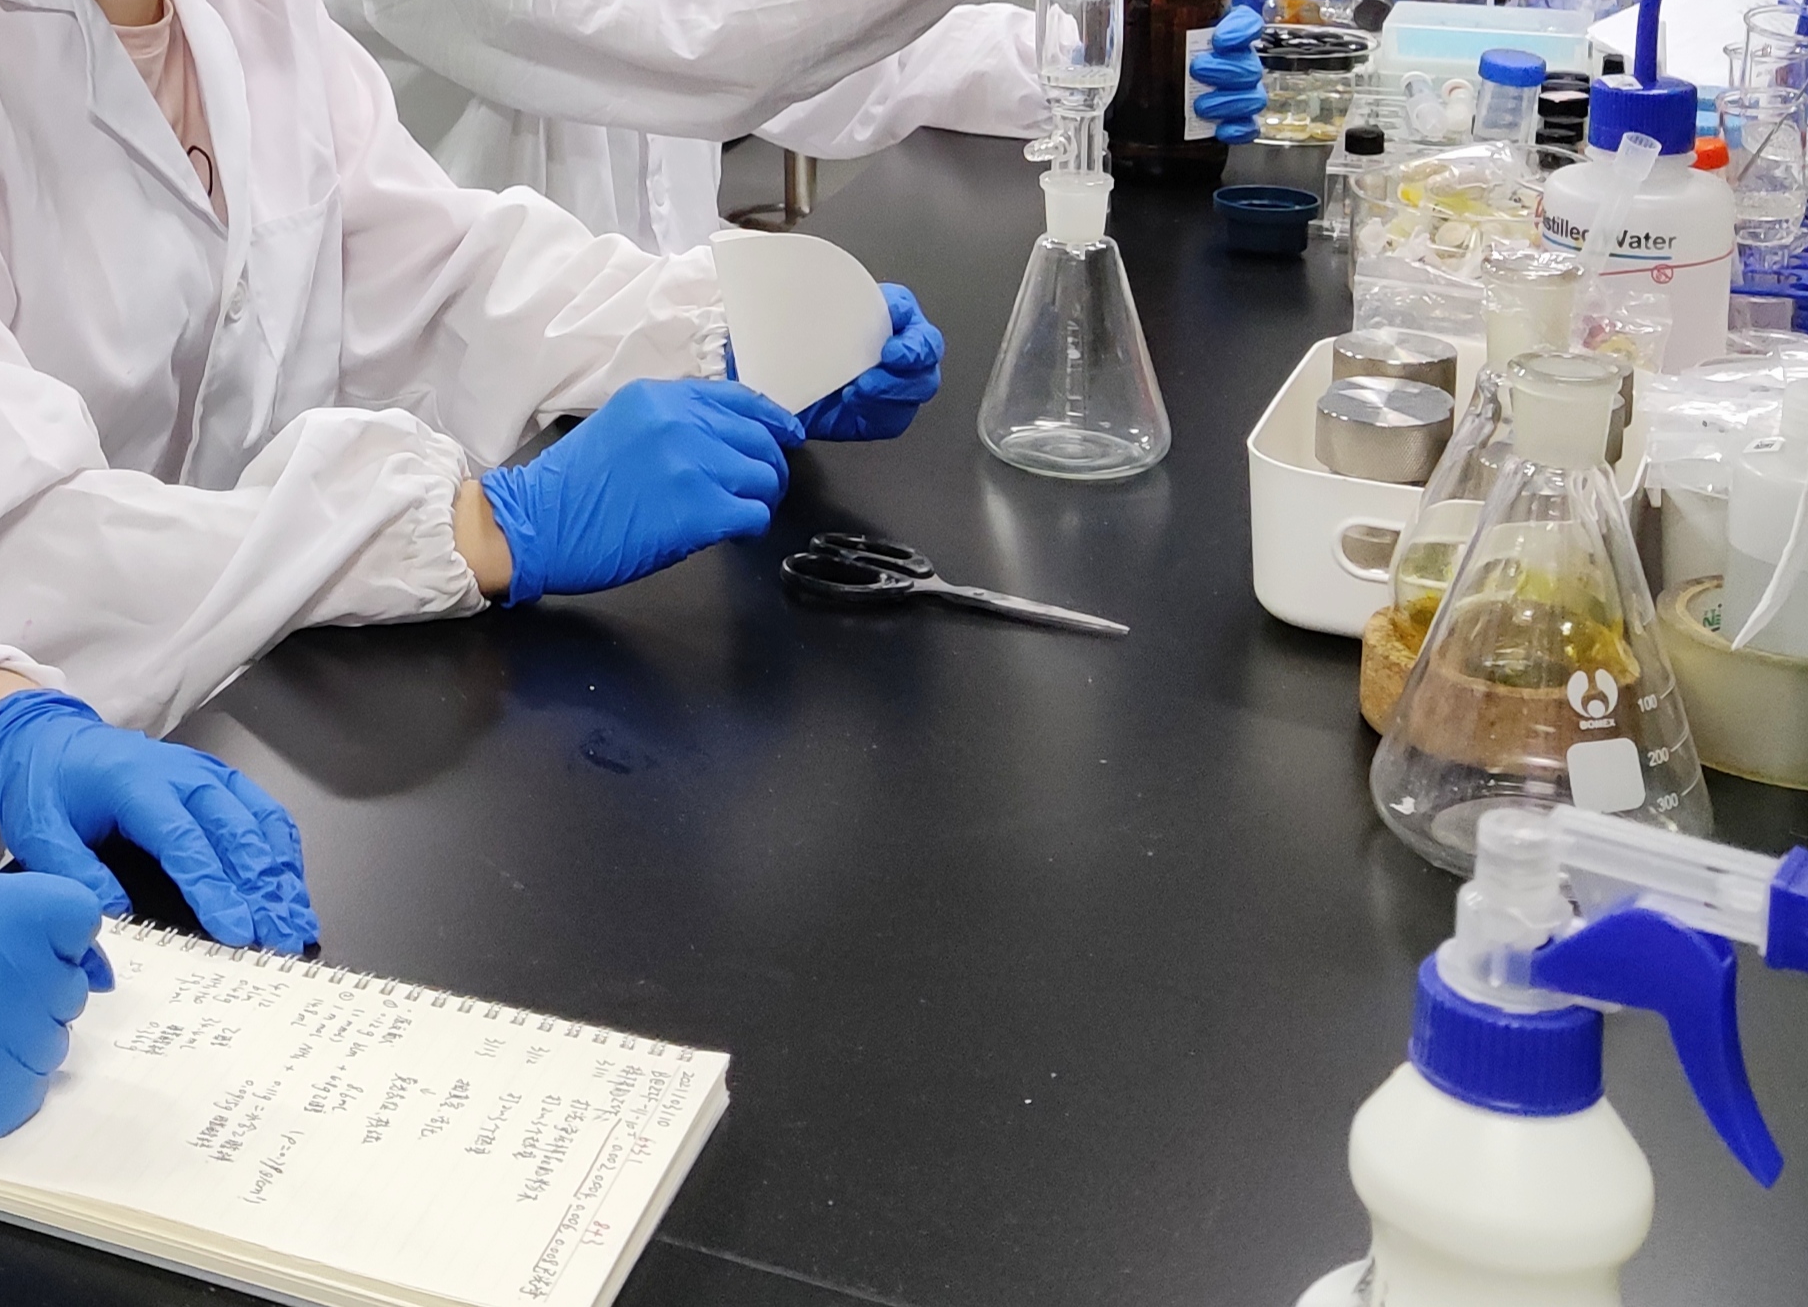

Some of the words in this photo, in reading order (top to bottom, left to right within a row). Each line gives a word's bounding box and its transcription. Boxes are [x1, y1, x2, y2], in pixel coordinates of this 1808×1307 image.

[1638, 694, 1658, 713] 100
[1647, 746, 1670, 767] 200
[1657, 793, 1679, 813] 300
[475, 1038, 506, 1057] 3/13
[657, 1071, 695, 1127] 2021/03/10
